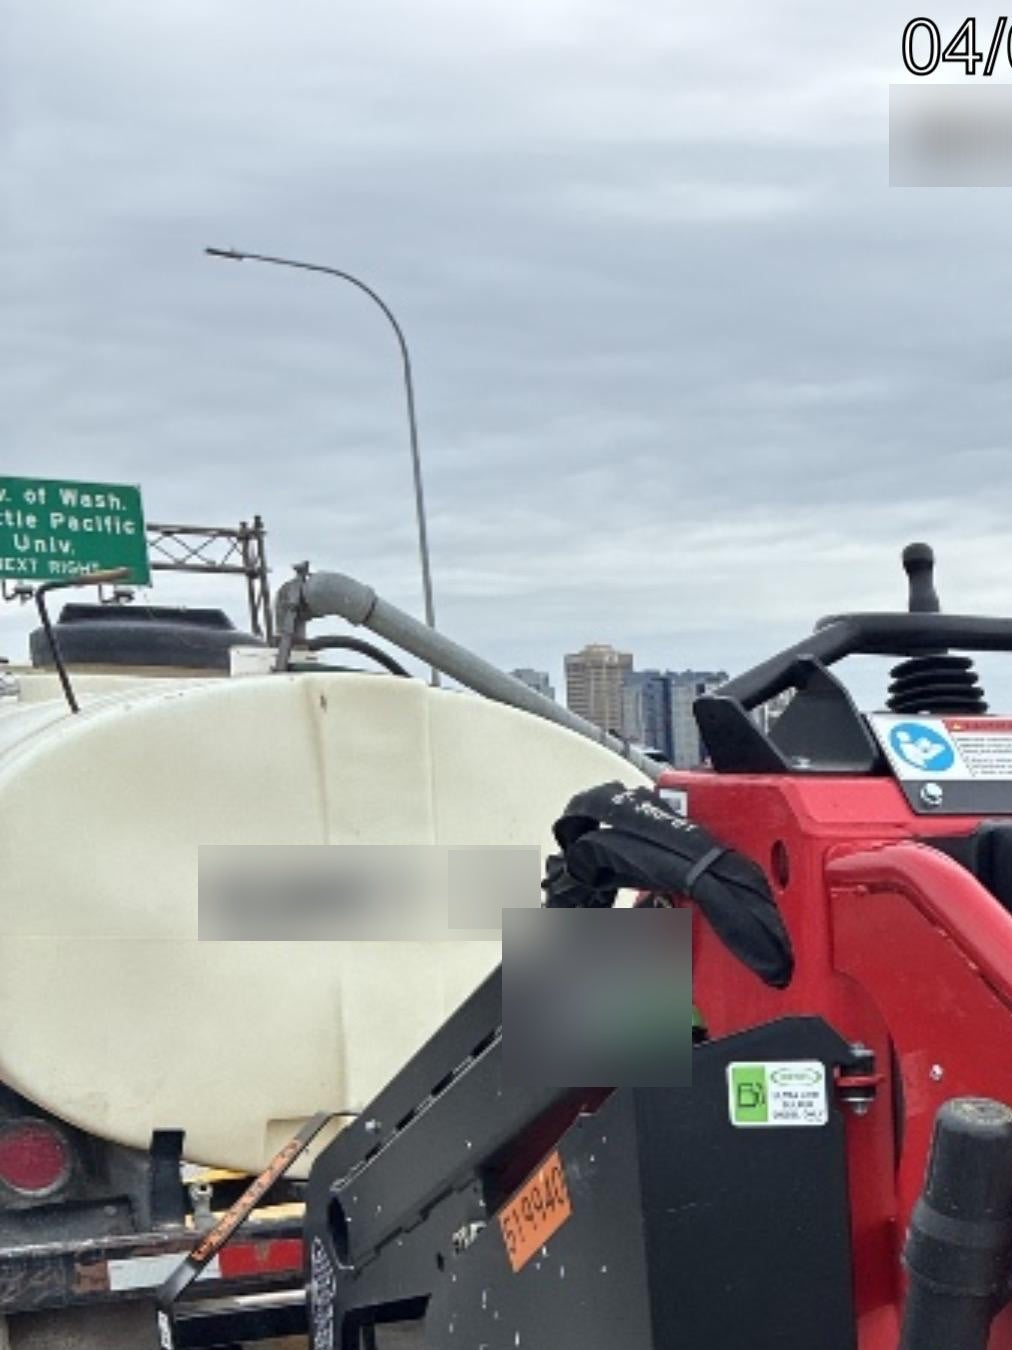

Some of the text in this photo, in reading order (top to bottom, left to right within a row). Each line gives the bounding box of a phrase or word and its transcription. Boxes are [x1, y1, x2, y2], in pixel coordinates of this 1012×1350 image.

[24, 488, 46, 505] of
[59, 488, 127, 511] Wash.
[50, 512, 136, 535] Pacific
[13, 533, 76, 556] Univ.
